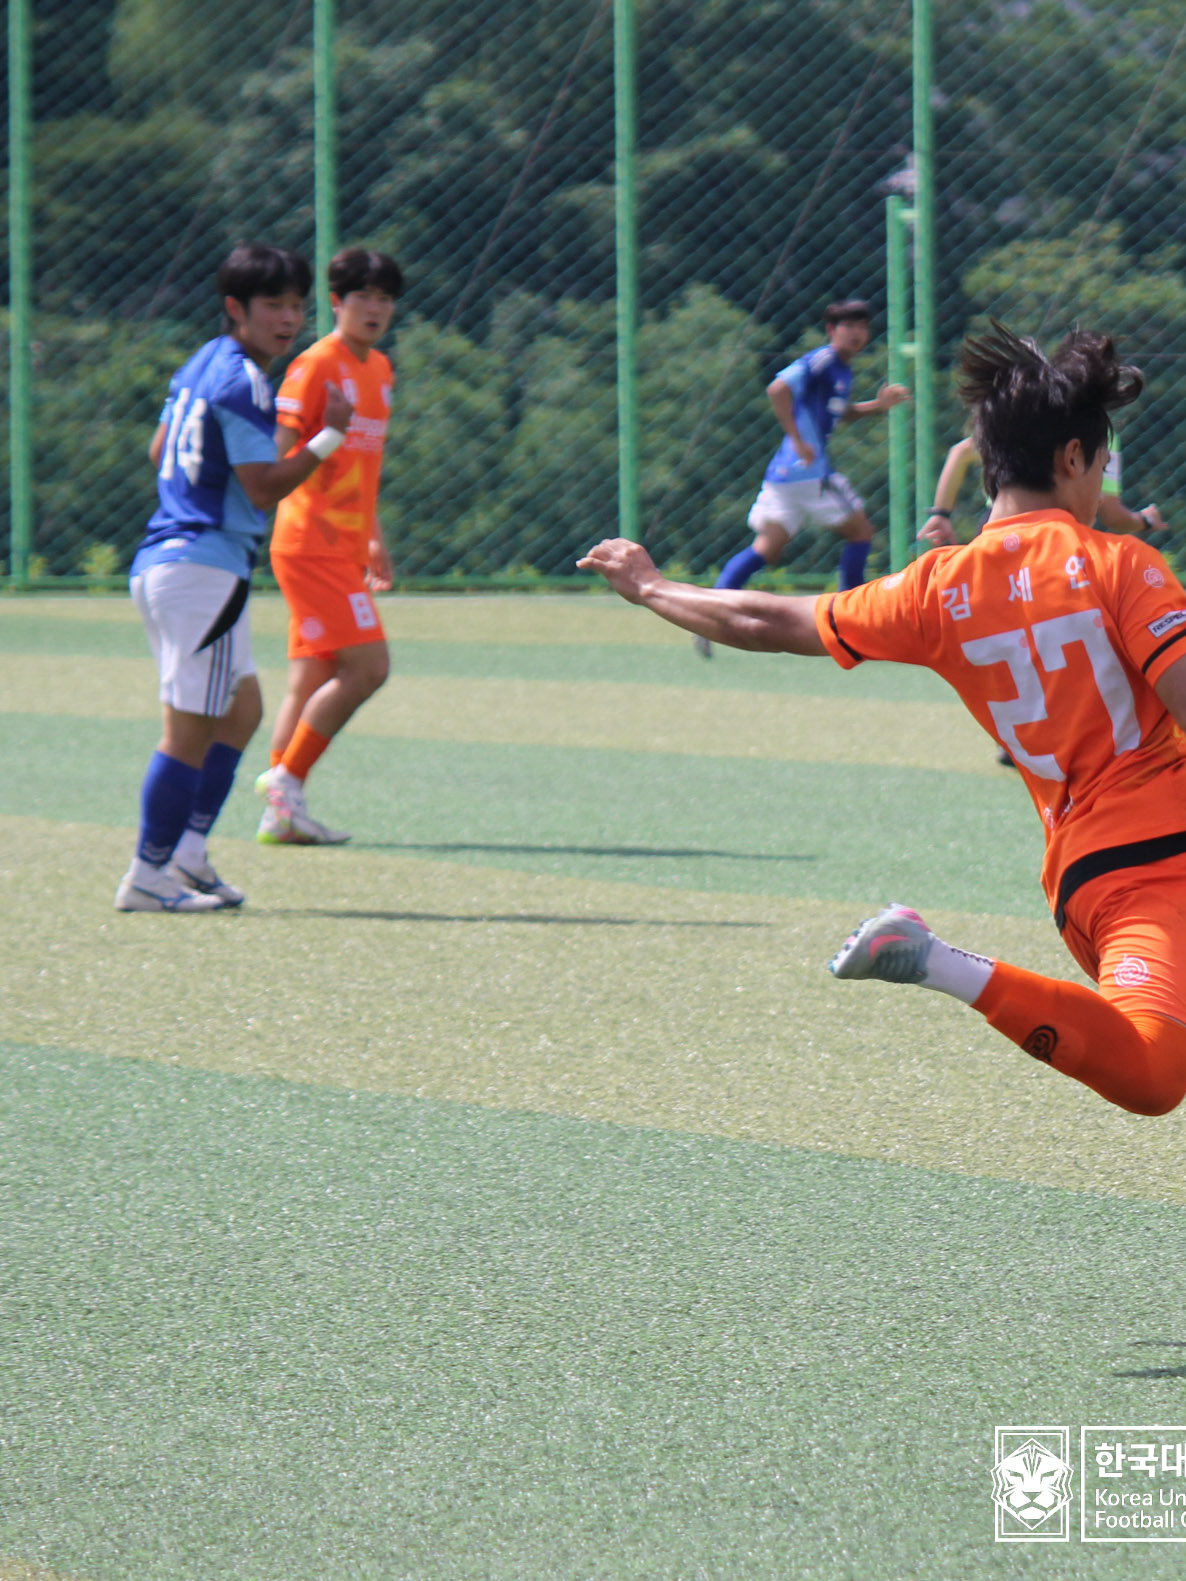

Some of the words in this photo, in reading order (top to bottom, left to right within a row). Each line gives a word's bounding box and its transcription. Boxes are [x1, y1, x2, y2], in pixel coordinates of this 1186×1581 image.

[160, 386, 207, 486] 14
[348, 591, 377, 629] 8
[961, 608, 1142, 783] 27
